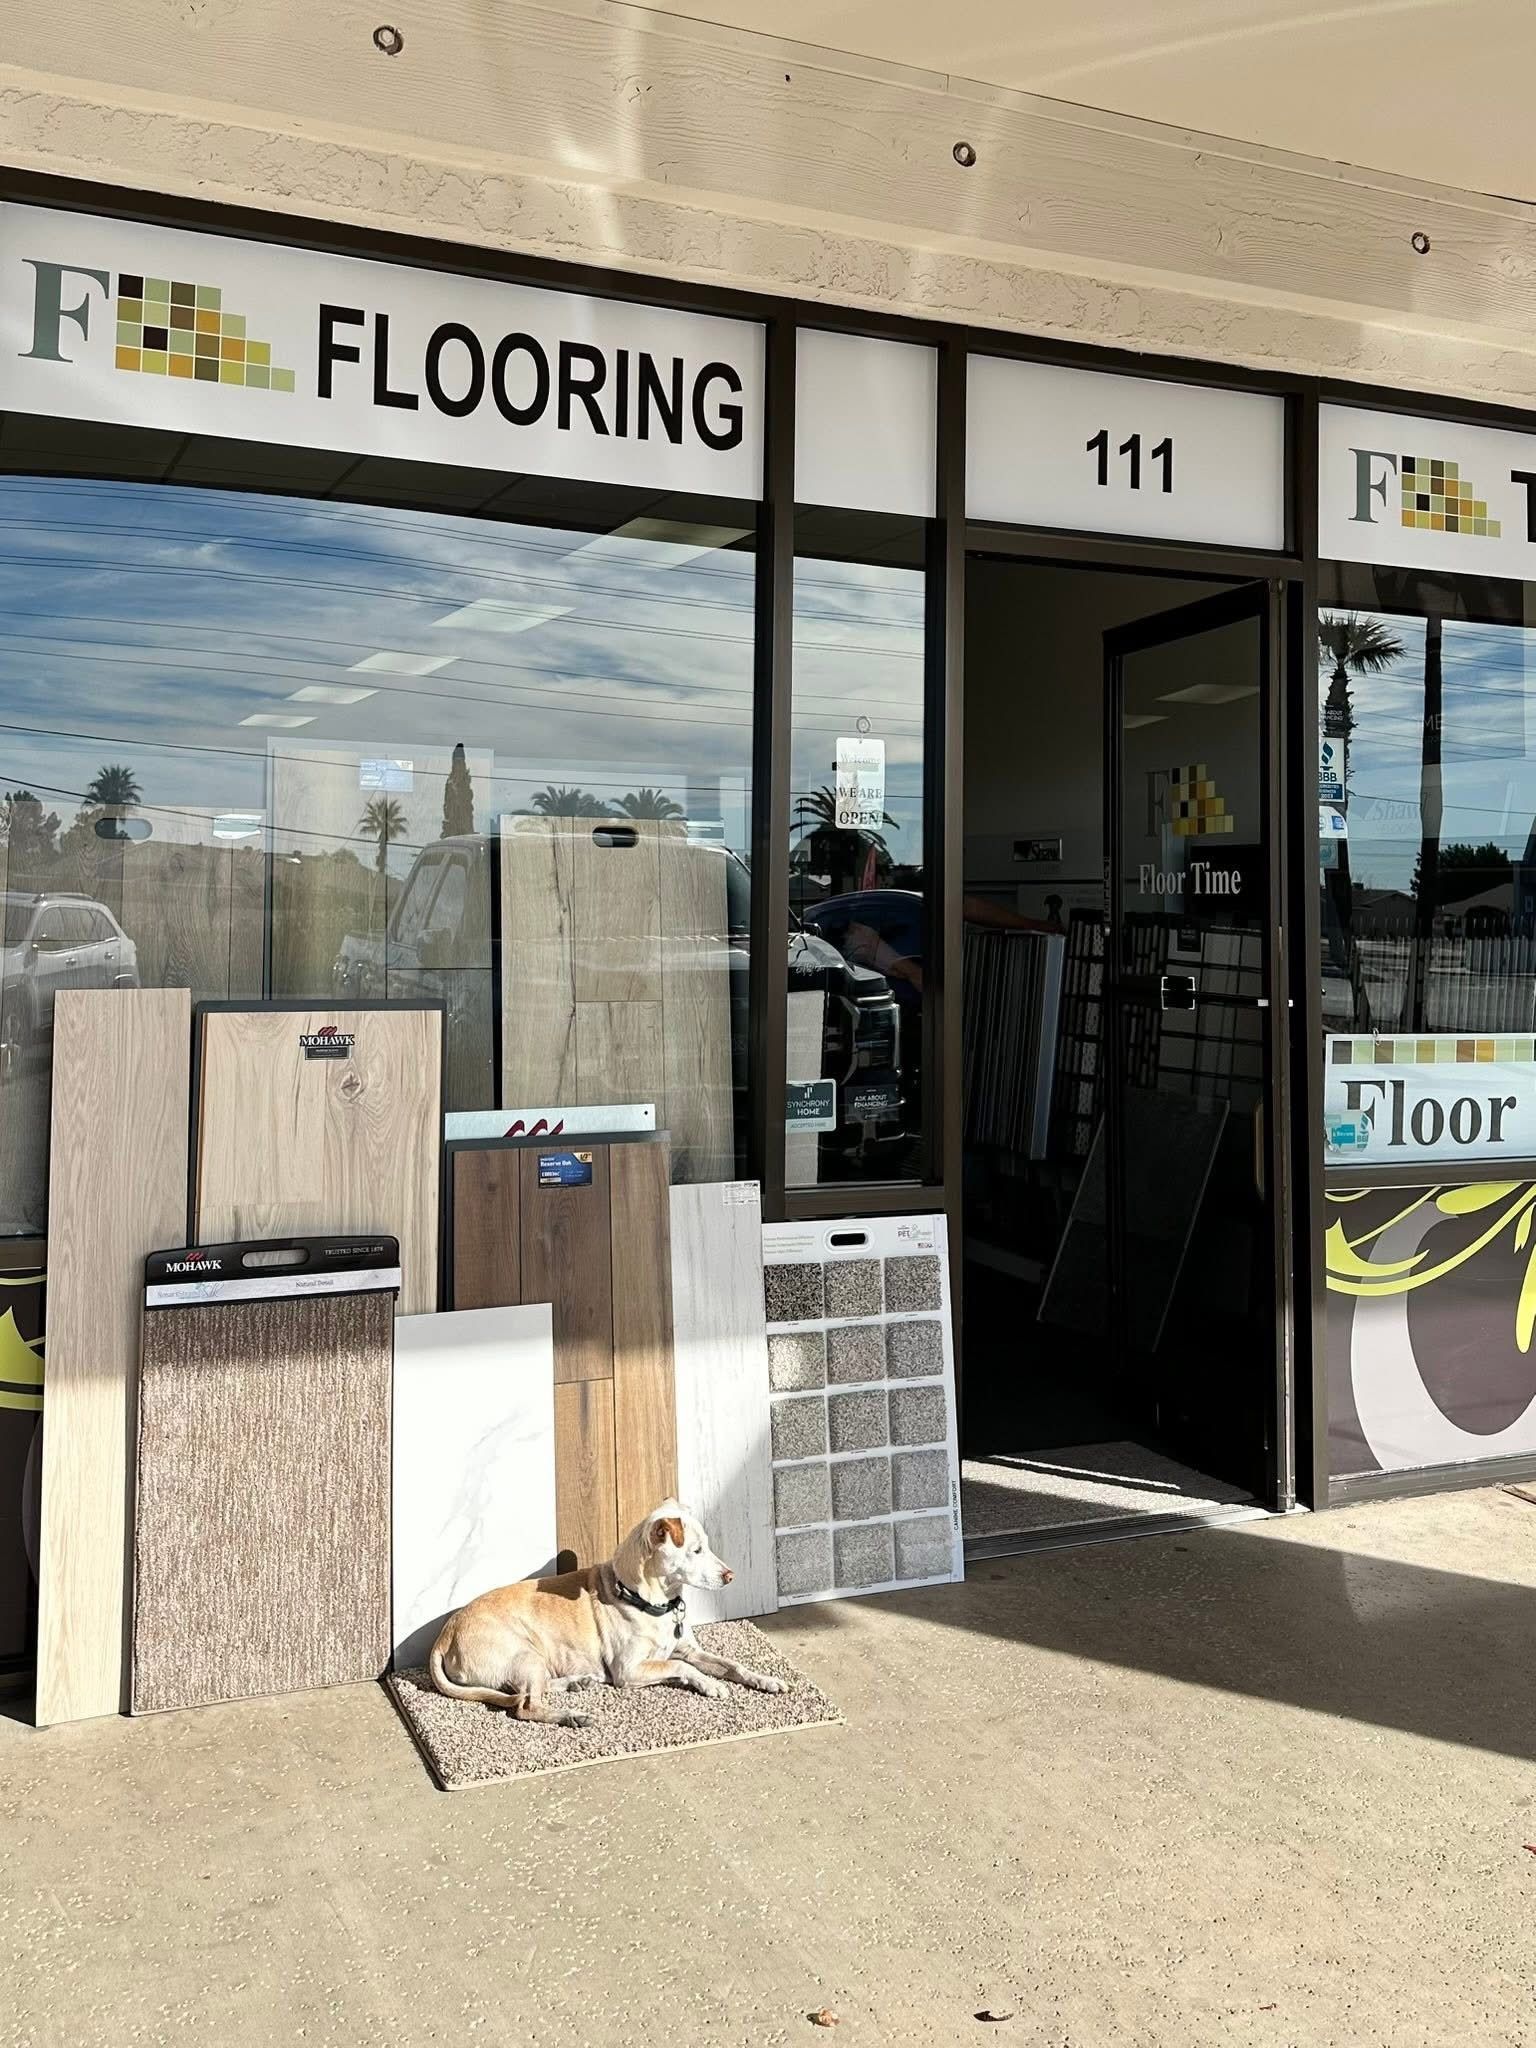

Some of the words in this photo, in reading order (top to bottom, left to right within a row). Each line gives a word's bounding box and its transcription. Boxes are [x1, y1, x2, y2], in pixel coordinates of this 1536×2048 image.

[18, 258, 110, 364] F
[317, 303, 744, 453] FLOORING
[1086, 429, 1174, 494] 111
[1347, 447, 1398, 524] F
[839, 787, 857, 798] WE
[859, 788, 882, 799] ARE
[839, 811, 881, 825] OPEN
[1139, 863, 1187, 895] Floor
[1190, 861, 1242, 895] Time
[300, 1035, 355, 1047] MOHAWK
[787, 1099, 830, 1109] SYNCHRONY
[797, 1108, 820, 1116] HOME
[1340, 1079, 1517, 1147] Floor
[165, 1259, 222, 1274] MOHAWK
